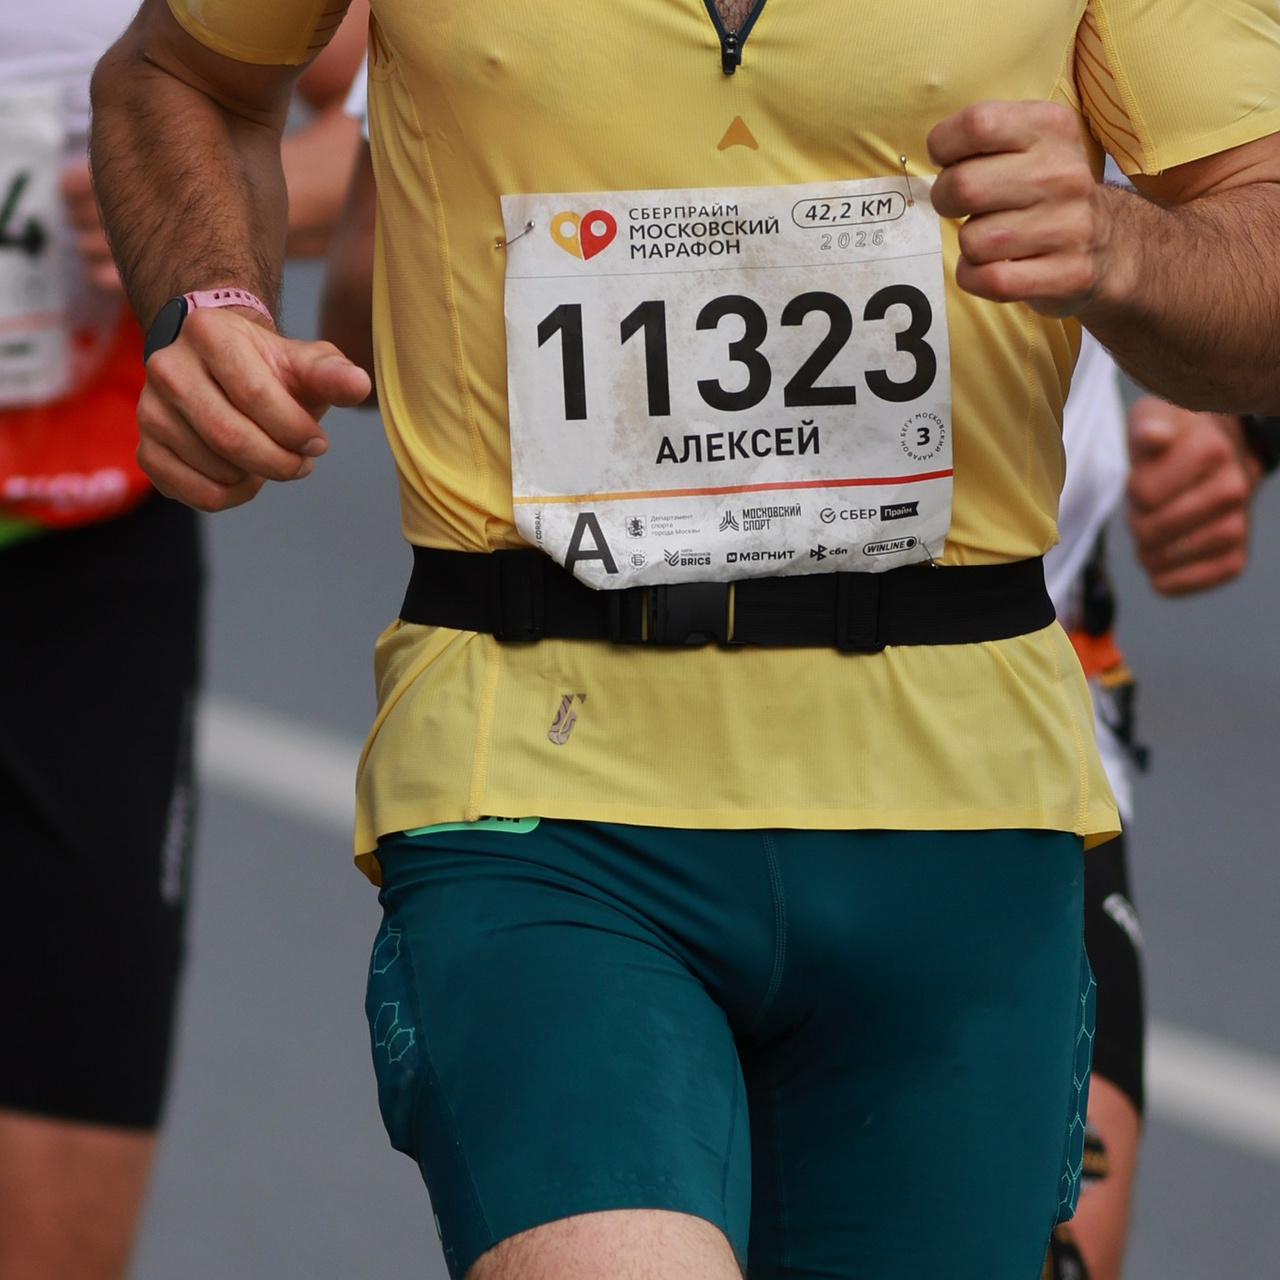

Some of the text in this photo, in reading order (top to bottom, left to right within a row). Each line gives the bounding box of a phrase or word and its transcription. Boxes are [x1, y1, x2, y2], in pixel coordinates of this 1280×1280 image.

[629, 202, 739, 220] СБЕРПРАЙМ
[805, 197, 893, 223] 42,2 КМ
[629, 216, 780, 240] МОСКОВСКИЙ
[820, 228, 885, 250] 2026
[630, 239, 741, 260] МАРАФОН
[537, 283, 937, 420] 11323
[655, 418, 821, 465] АЛЕКСЕЙ
[917, 426, 931, 446] 3
[742, 503, 802, 519] МОСКОВСКИЙ
[840, 507, 912, 521] СБЕР Прайм
[650, 515, 693, 523] Департамент
[651, 522, 674, 530] спорта
[743, 519, 770, 531] СПОРТ
[651, 529, 675, 537] города
[829, 548, 848, 556] сбп
[867, 540, 905, 553] WINLINE
[681, 556, 711, 567] BRICS
[739, 550, 795, 562] магнит
